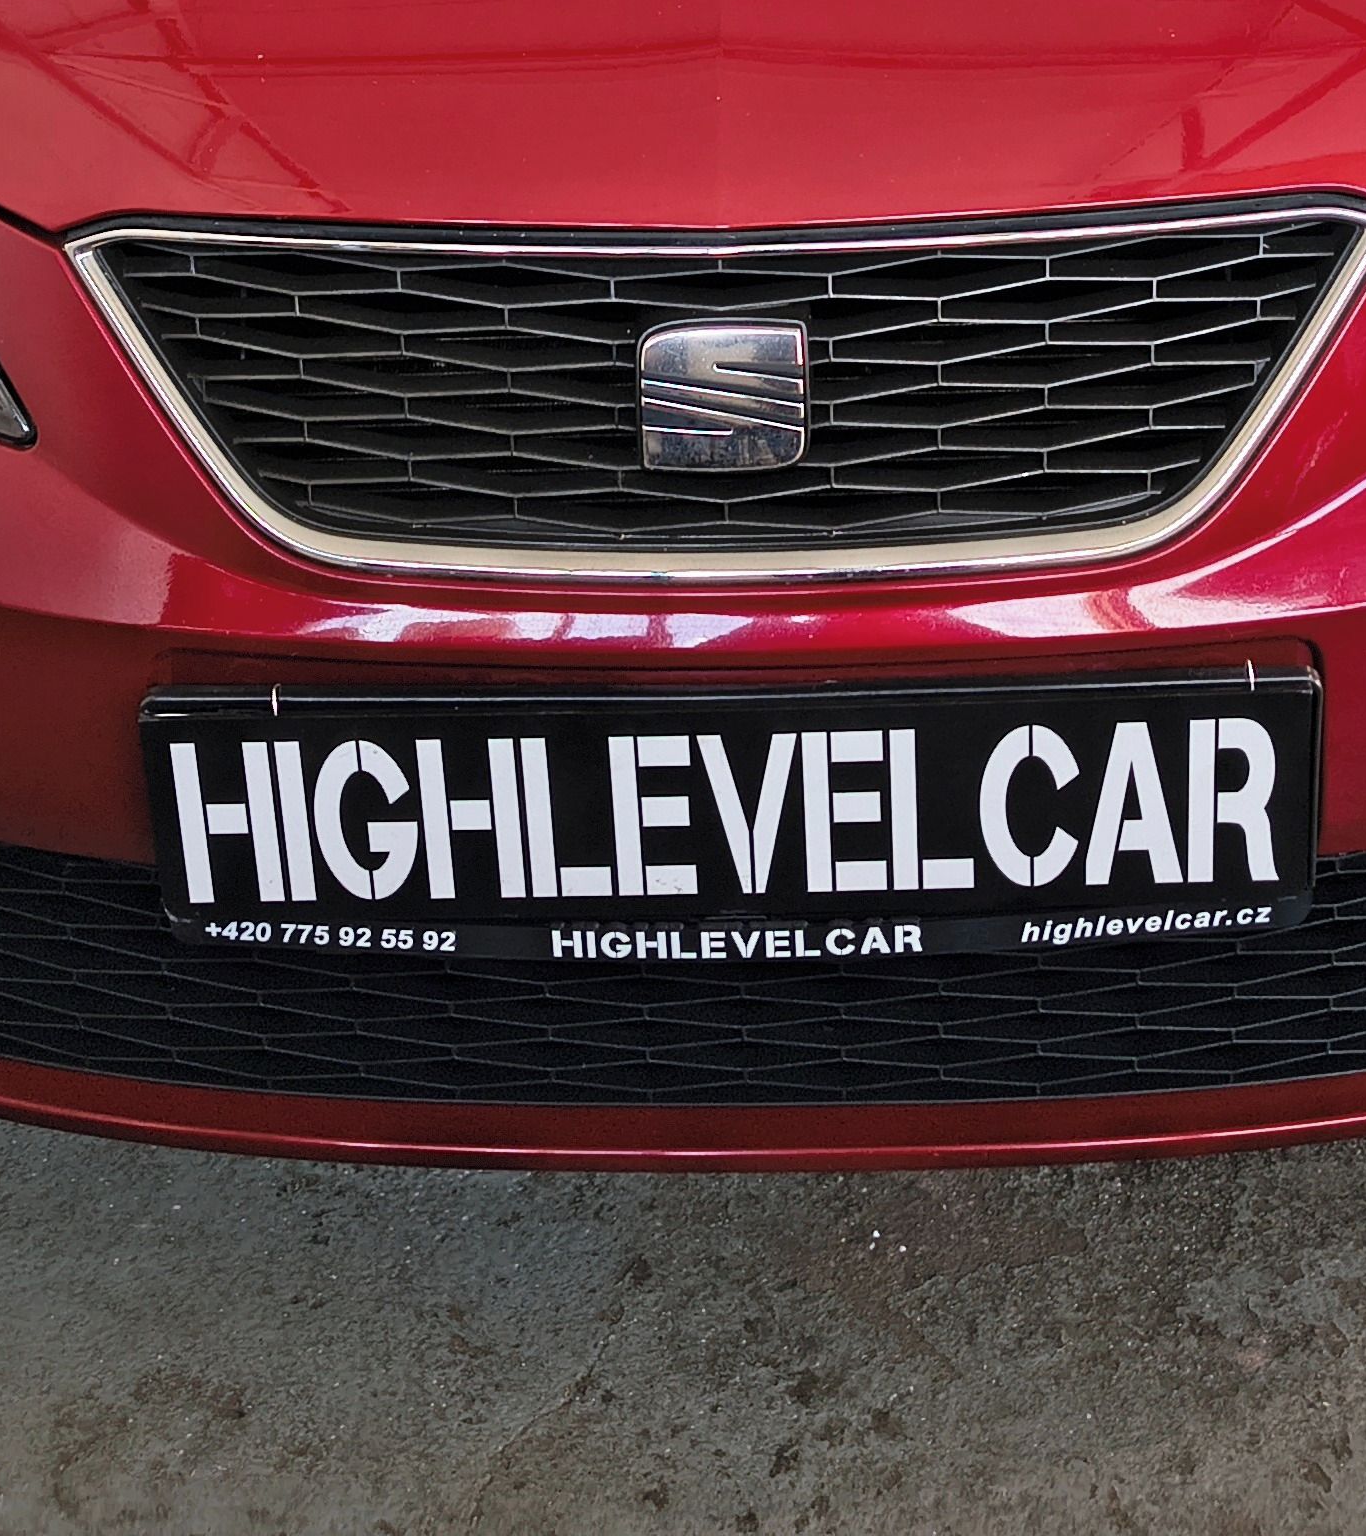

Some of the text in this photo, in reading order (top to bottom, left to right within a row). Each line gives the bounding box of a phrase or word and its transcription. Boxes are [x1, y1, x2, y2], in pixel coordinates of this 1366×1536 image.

[205, 921, 457, 952] +420 775 92 55 92
[551, 924, 923, 959] HIGHLEVELCAR
[1021, 906, 1273, 945] highlevelcar.cz
